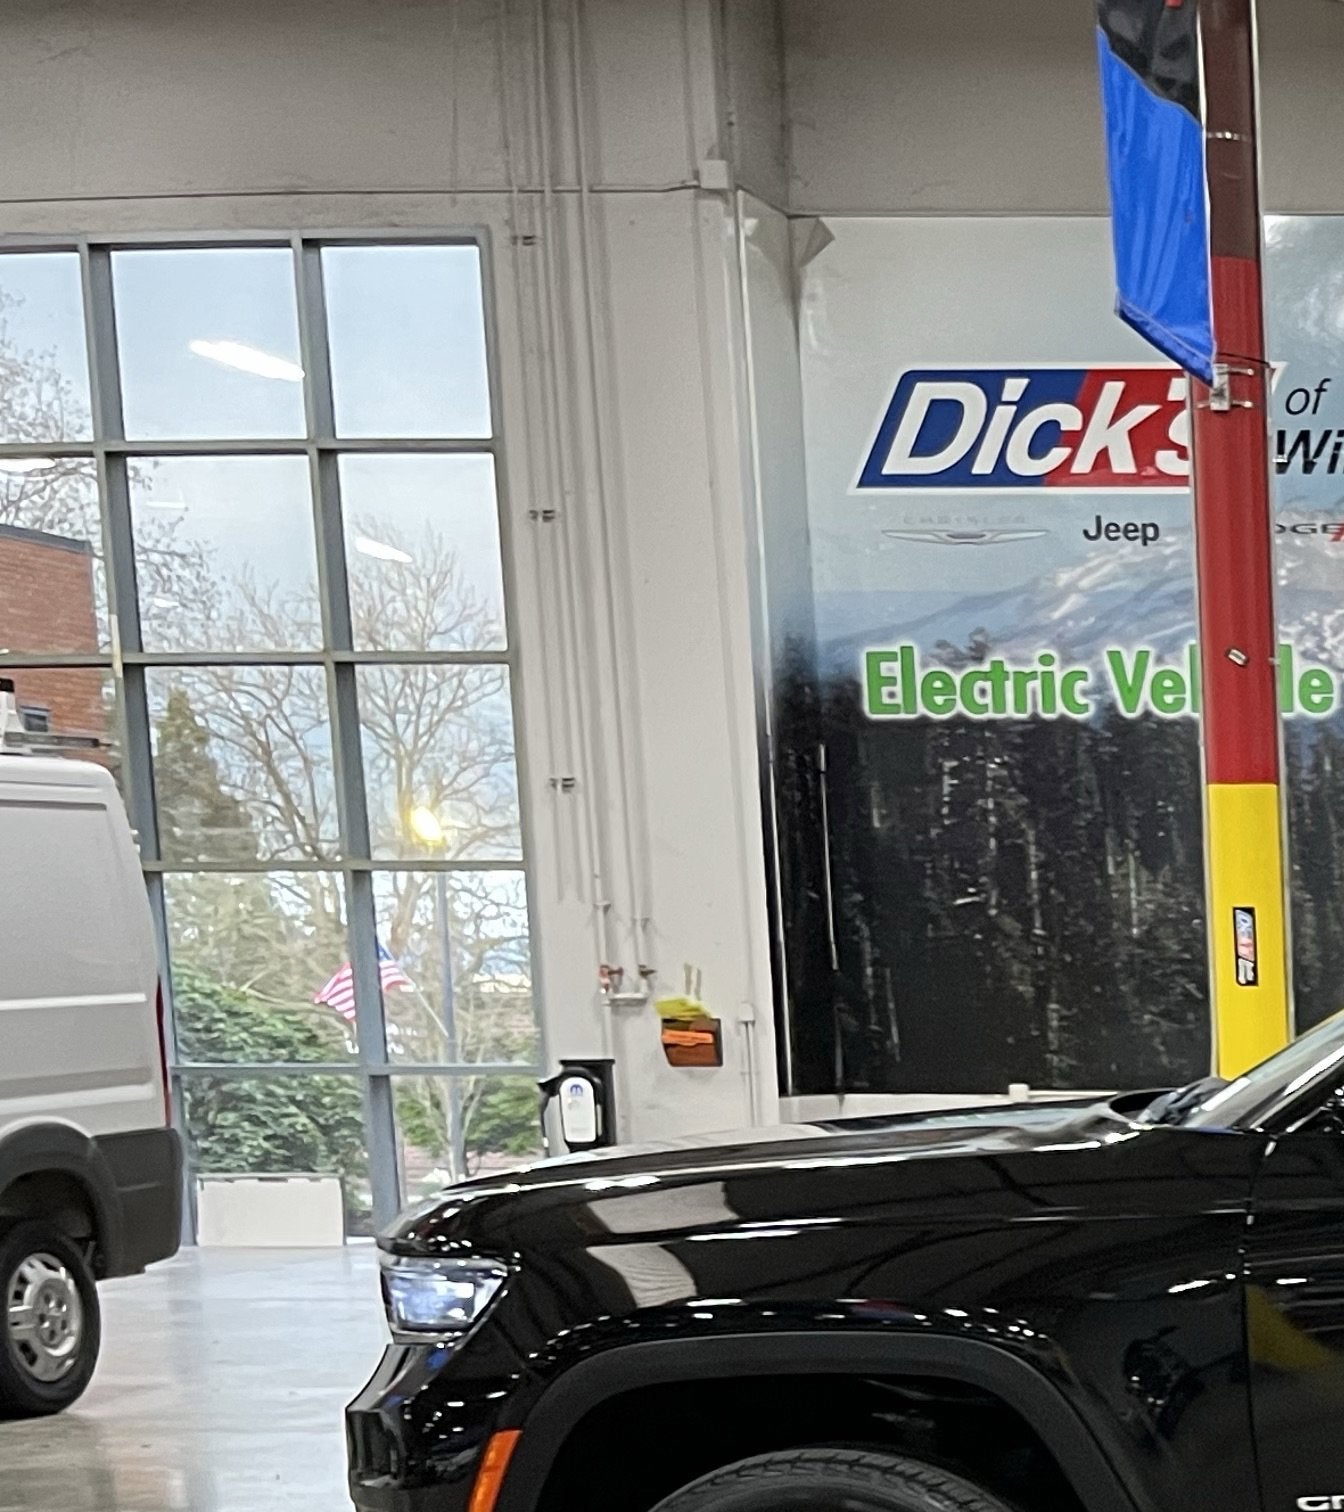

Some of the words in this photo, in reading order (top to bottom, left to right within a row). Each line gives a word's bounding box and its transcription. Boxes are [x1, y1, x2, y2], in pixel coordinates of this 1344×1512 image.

[1285, 378, 1331, 416] of
[881, 377, 1189, 477] Dick's
[1082, 514, 1160, 547] Jeep
[864, 644, 1091, 716] Electric
[1104, 641, 1336, 716] Vele
